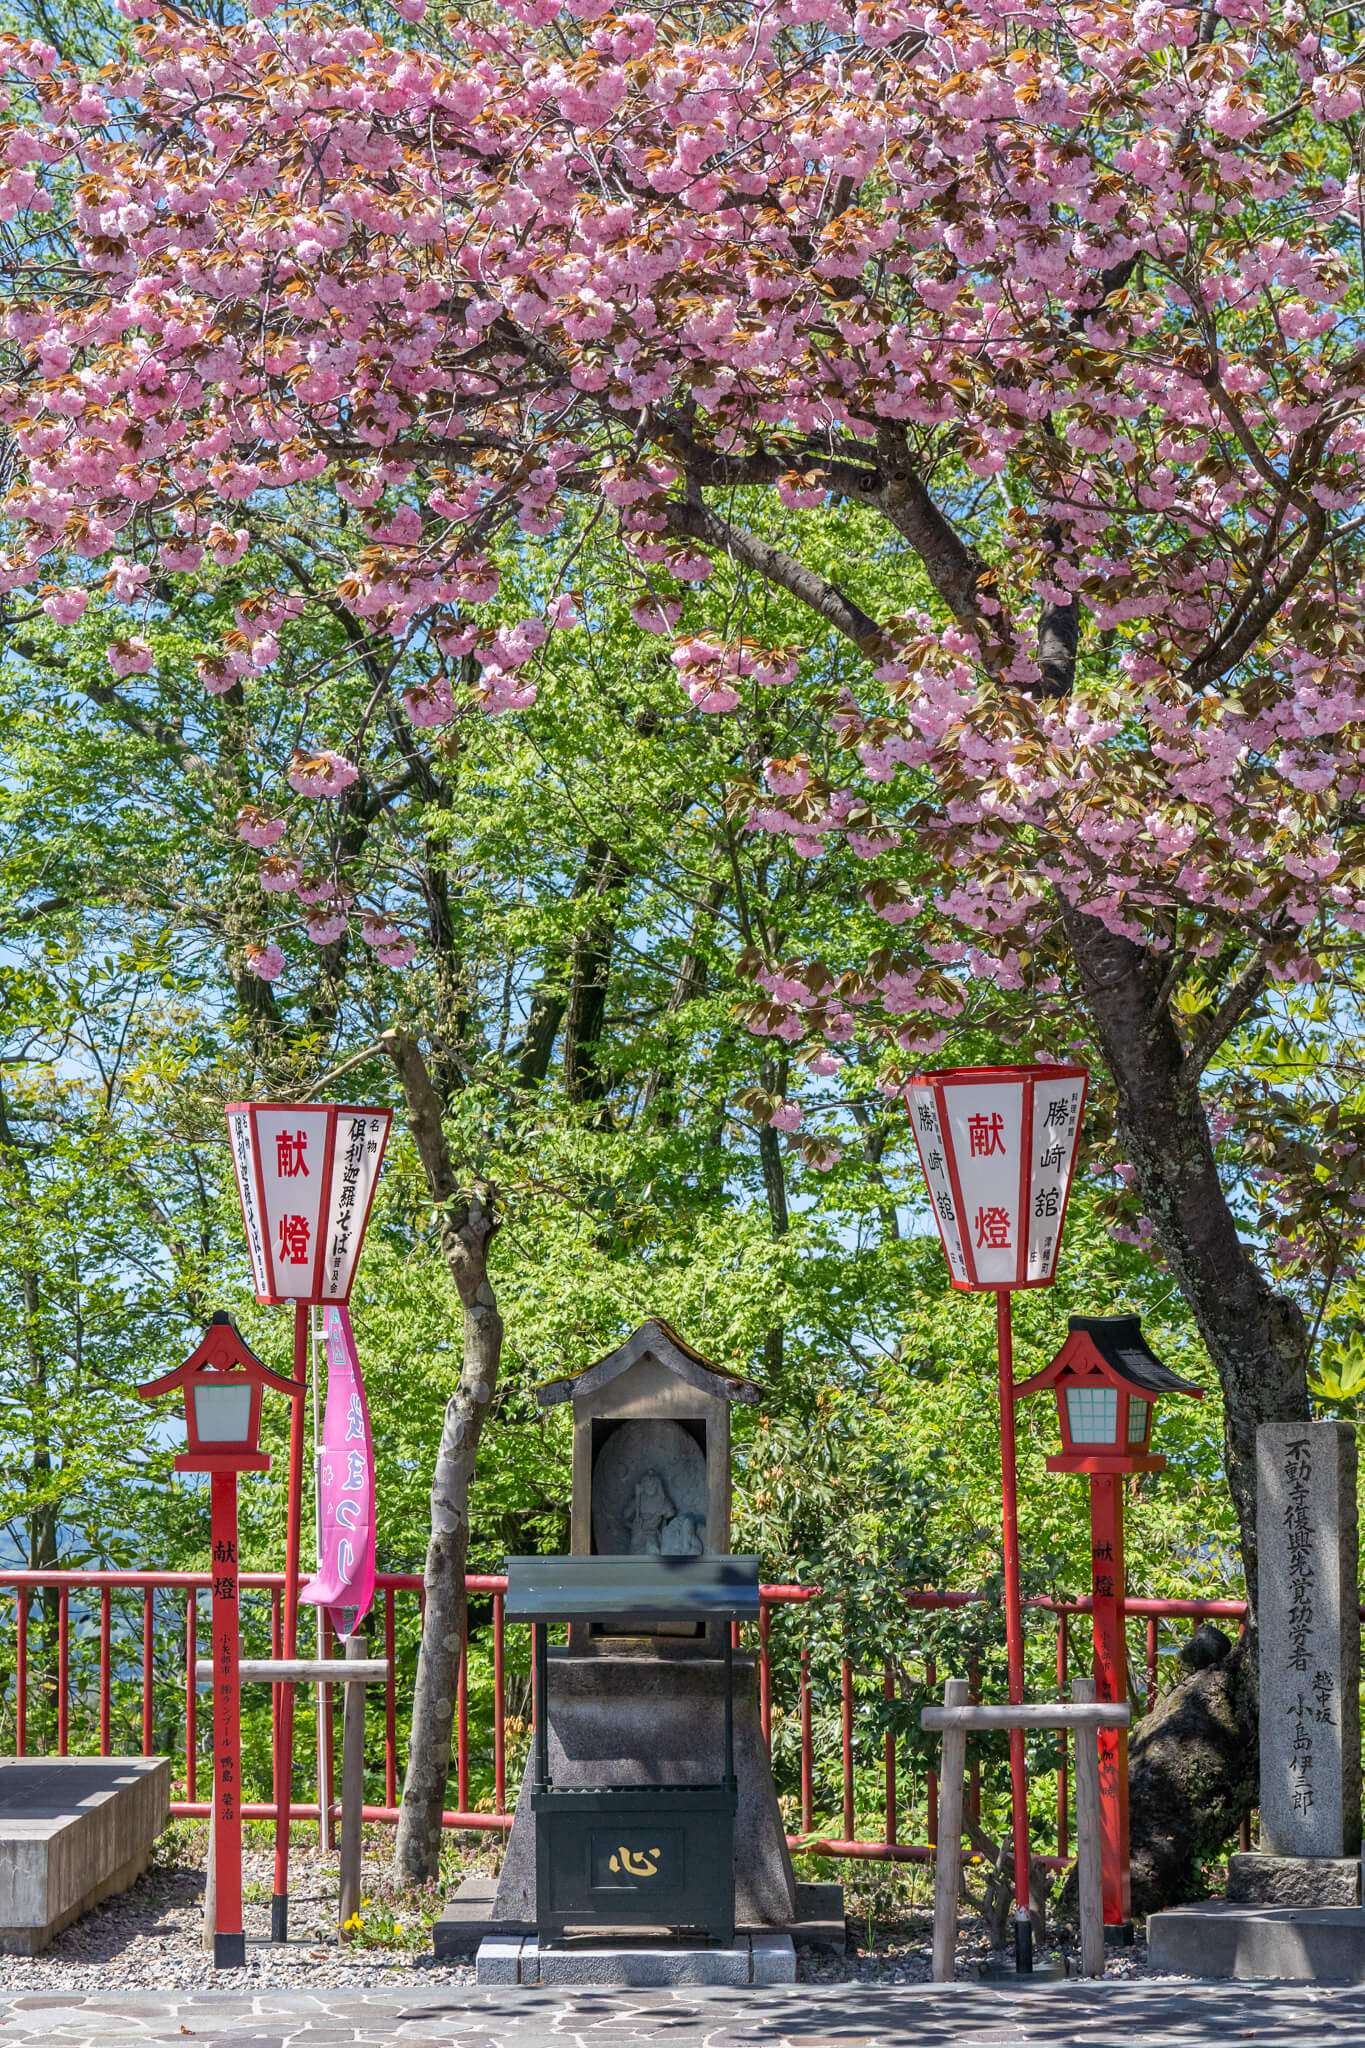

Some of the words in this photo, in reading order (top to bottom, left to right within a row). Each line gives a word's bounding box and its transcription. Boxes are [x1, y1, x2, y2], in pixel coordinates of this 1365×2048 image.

[366, 1119, 380, 1153] 名物
[275, 1130, 312, 1264] 献燈
[967, 1112, 1012, 1249] 献燈
[213, 1540, 236, 1600] 献燈
[1093, 1539, 1115, 1598] 献燈
[1311, 1671, 1338, 1726] 越中坂
[1286, 1694, 1314, 1816] 小島伊三郎
[608, 1846, 661, 1877] 心
